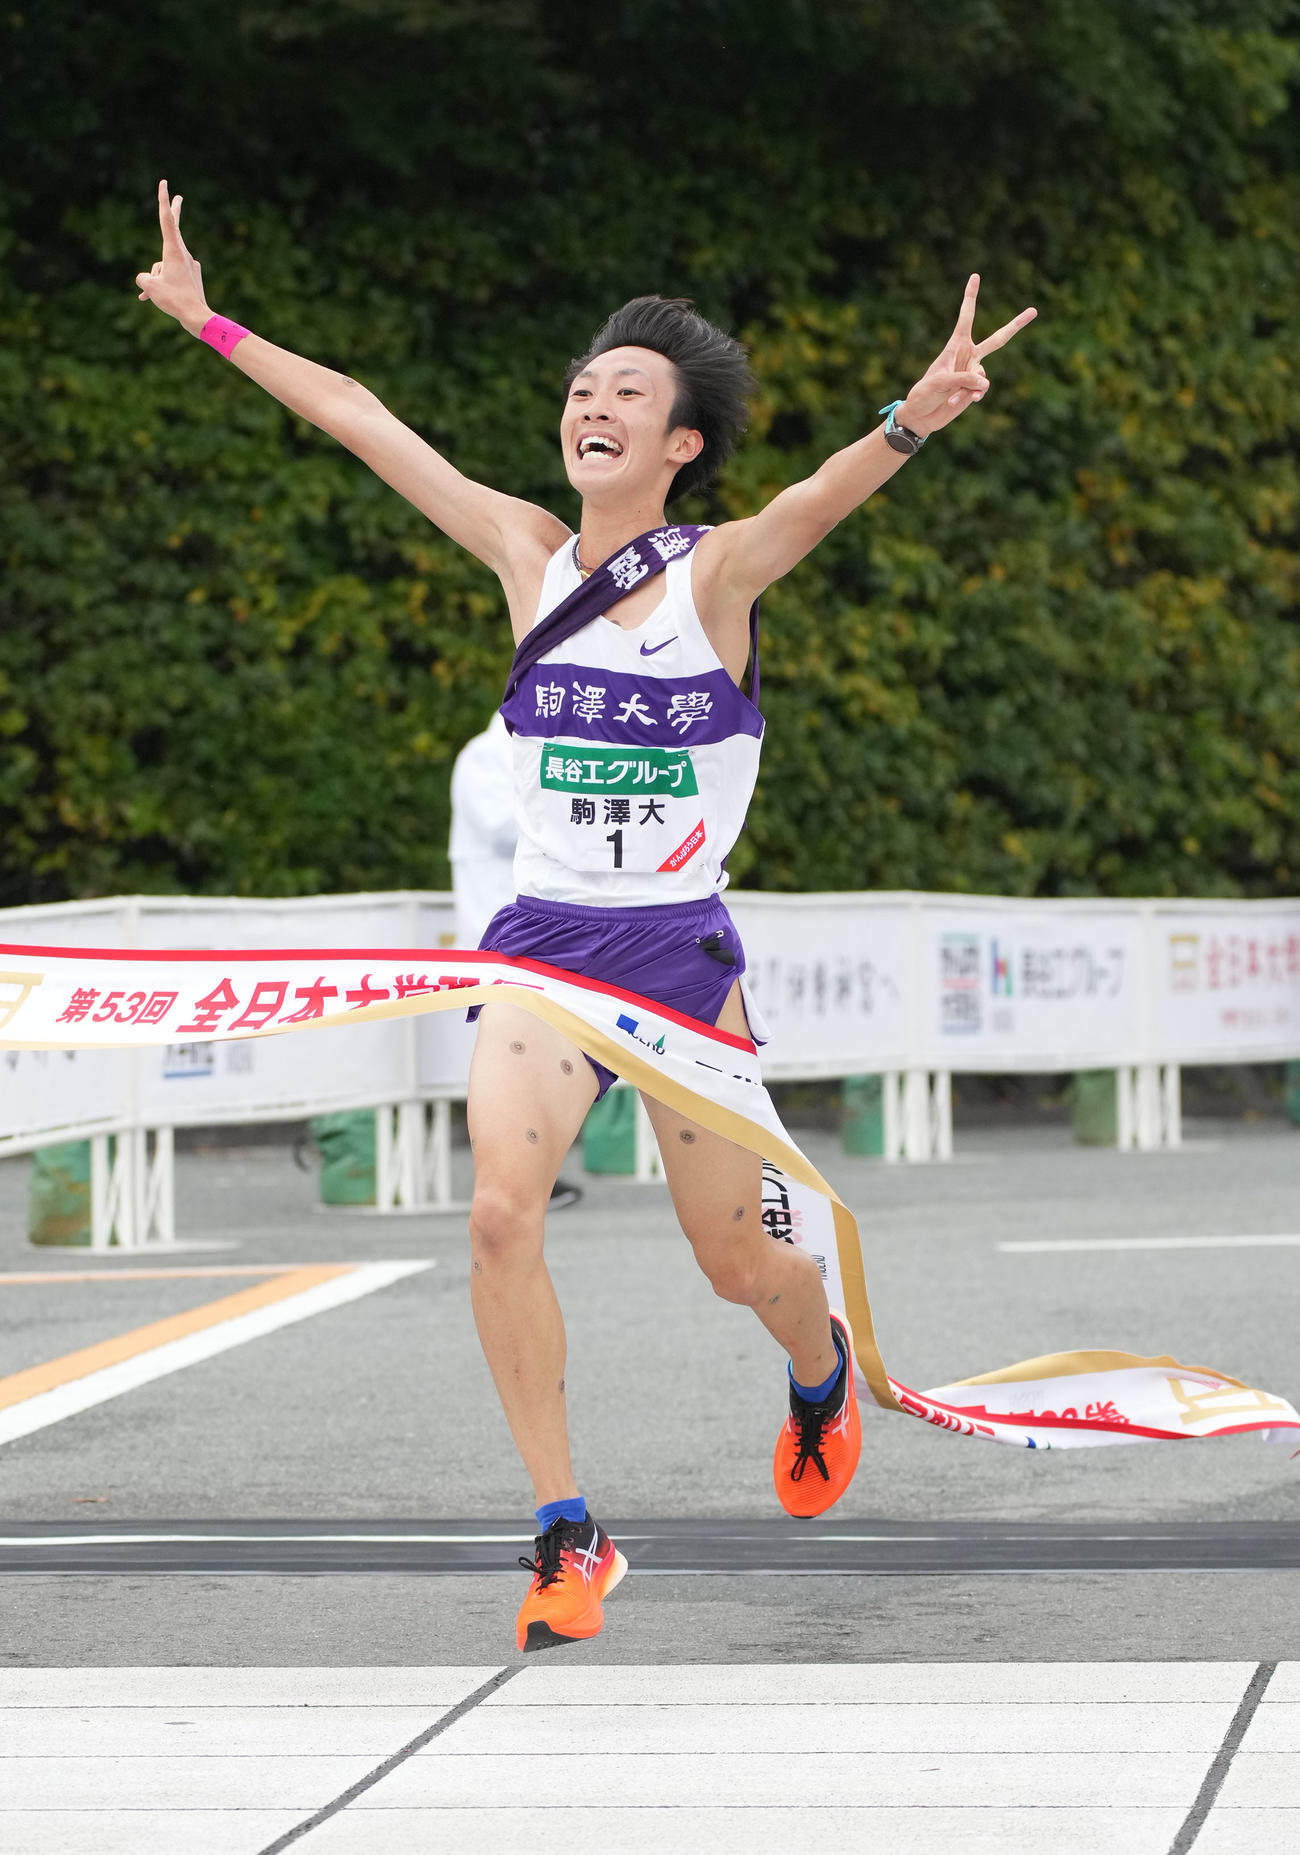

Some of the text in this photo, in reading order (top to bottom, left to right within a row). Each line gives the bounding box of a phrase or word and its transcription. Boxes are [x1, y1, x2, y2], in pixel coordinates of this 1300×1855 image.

[535, 681, 715, 735] 駒澤大學
[545, 756, 688, 788] 長谷工グループ
[570, 798, 665, 826] 駒澤大
[606, 829, 623, 869] 1
[670, 830, 703, 868] がんばろう日本
